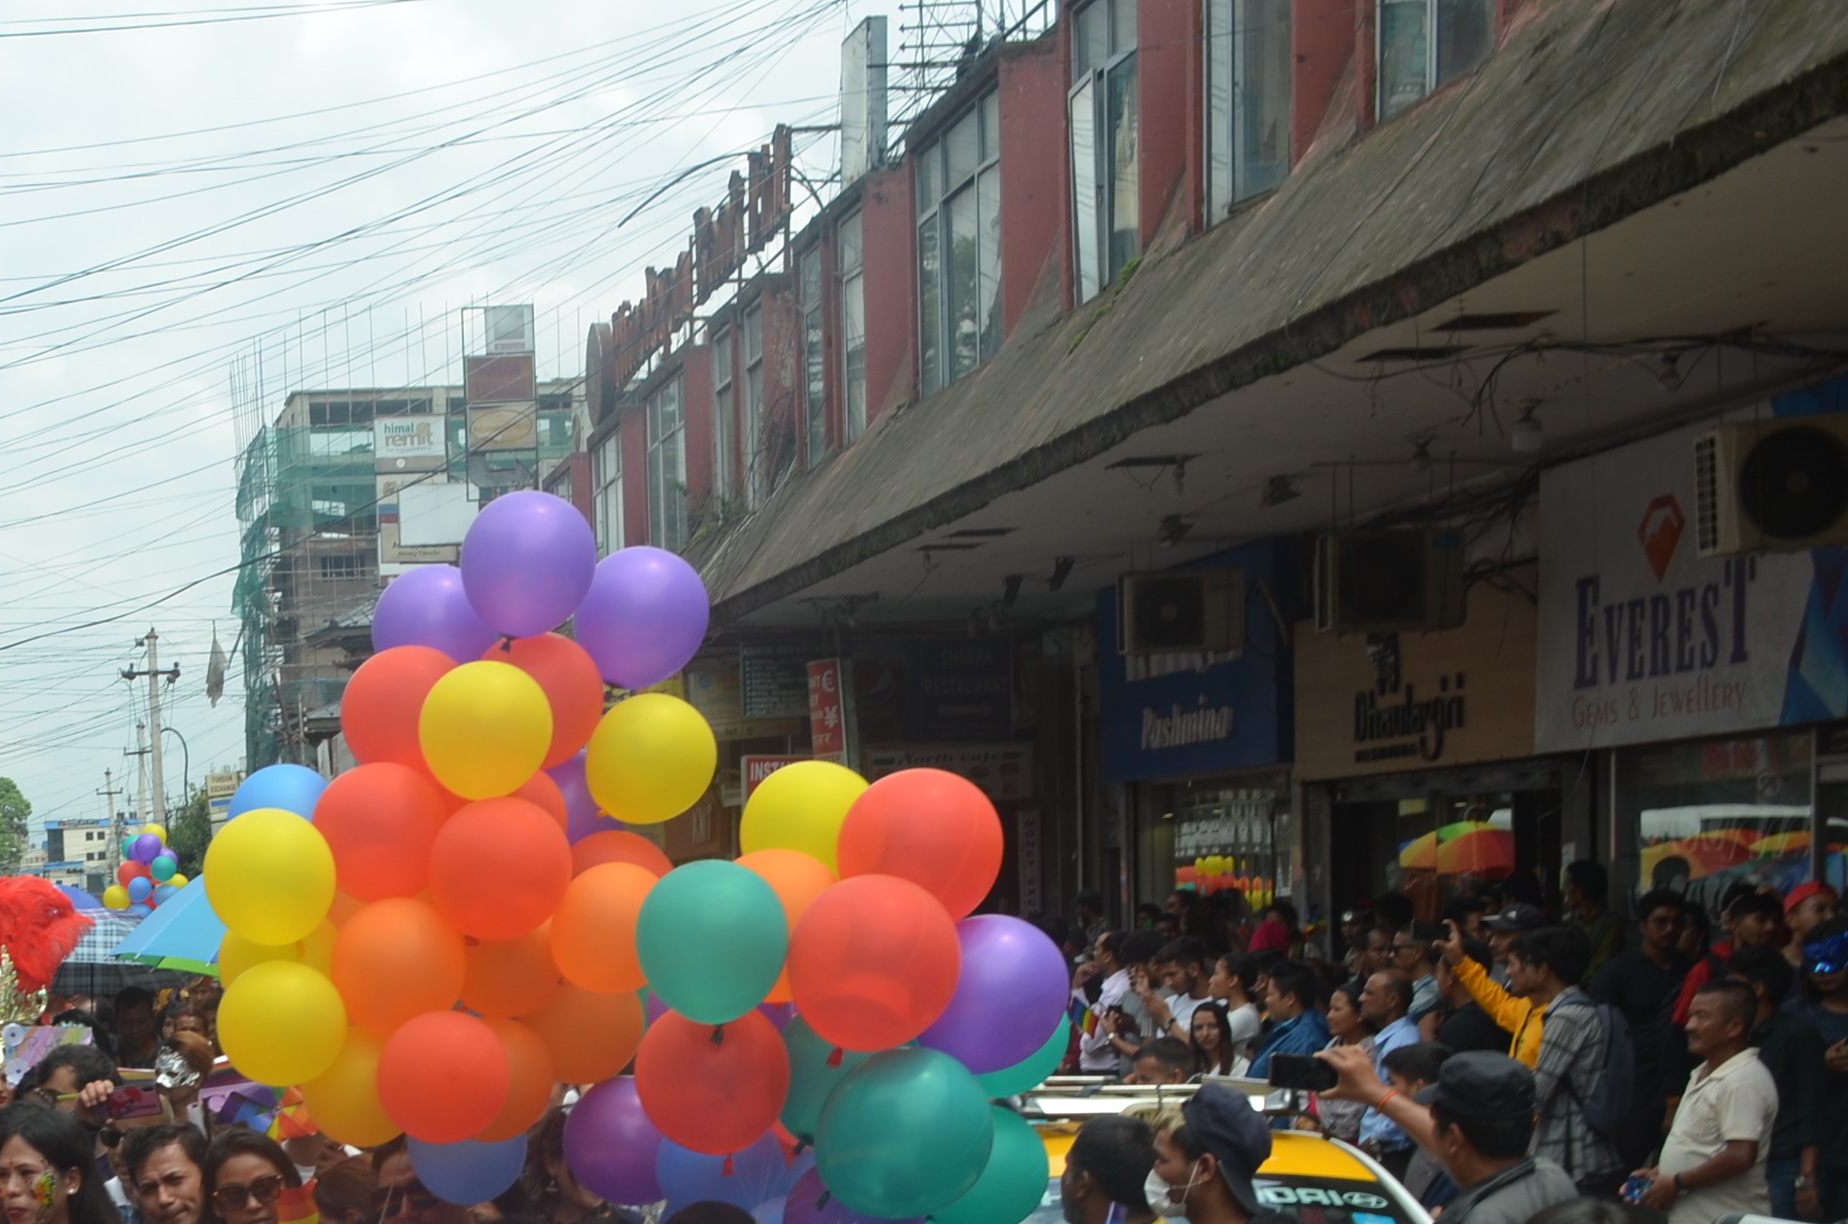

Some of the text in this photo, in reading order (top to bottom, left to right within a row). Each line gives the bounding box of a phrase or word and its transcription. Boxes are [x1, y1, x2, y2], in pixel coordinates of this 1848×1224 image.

[384, 422, 415, 434] himal
[1573, 557, 1756, 690] EVEREST
[924, 676, 1012, 697] RESTAURANT
[1627, 686, 1640, 720] &
[1141, 692, 1236, 751] Pashmina
[1354, 671, 1466, 762] Dhaulagiri
[1262, 1186, 1345, 1207] DAI
